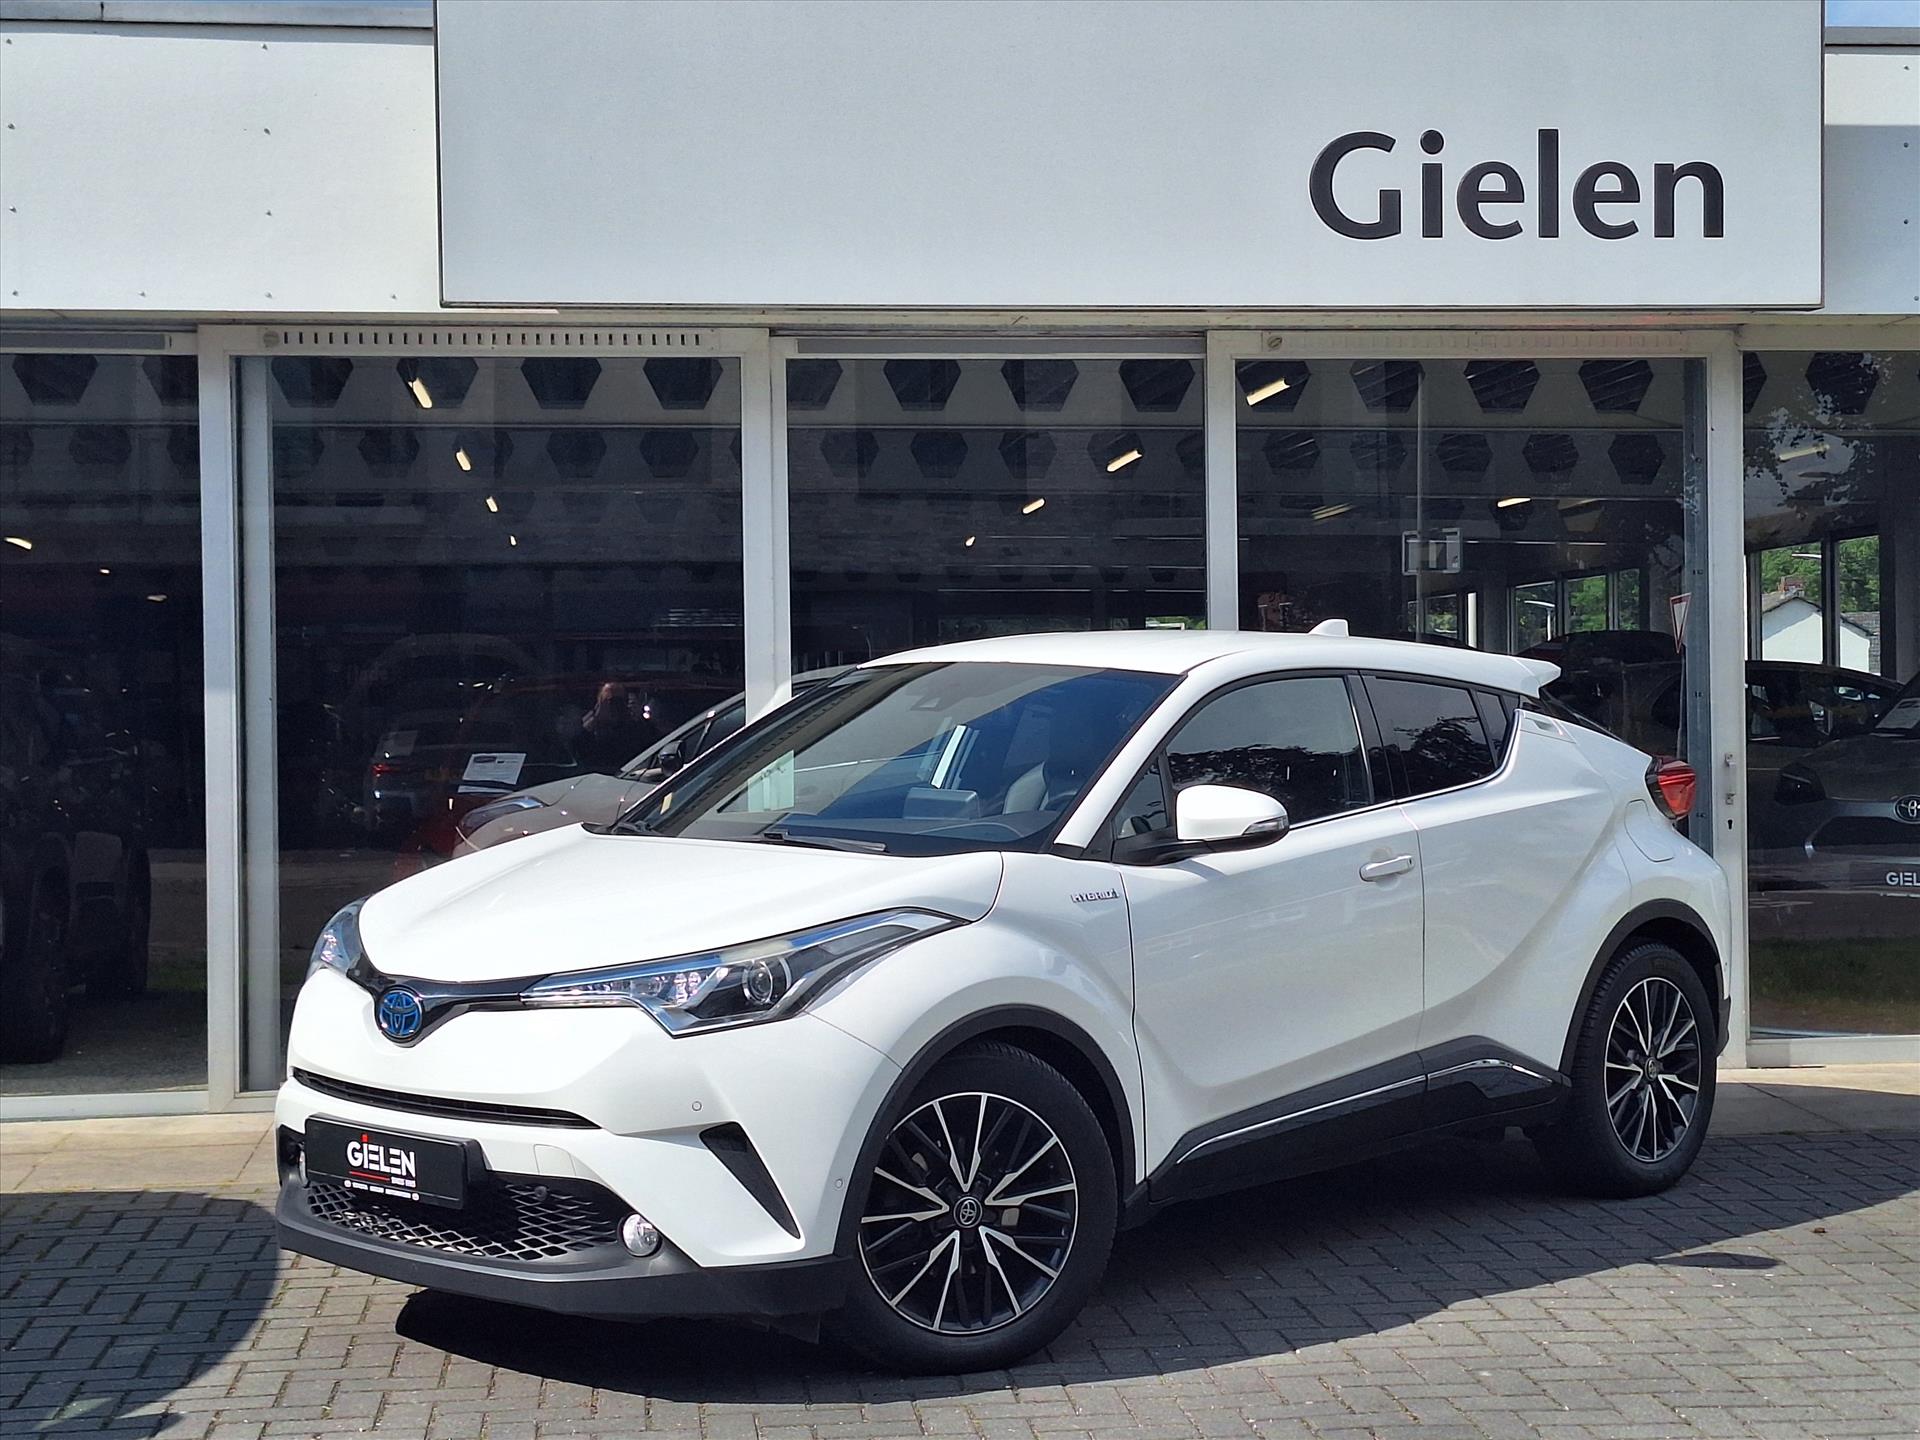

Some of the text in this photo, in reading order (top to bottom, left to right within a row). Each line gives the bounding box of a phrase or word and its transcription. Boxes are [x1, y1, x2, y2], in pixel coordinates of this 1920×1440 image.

[1309, 128, 1724, 240] Gielen
[1071, 891, 1114, 903] HYBRID
[346, 1135, 416, 1178] GIELEN
